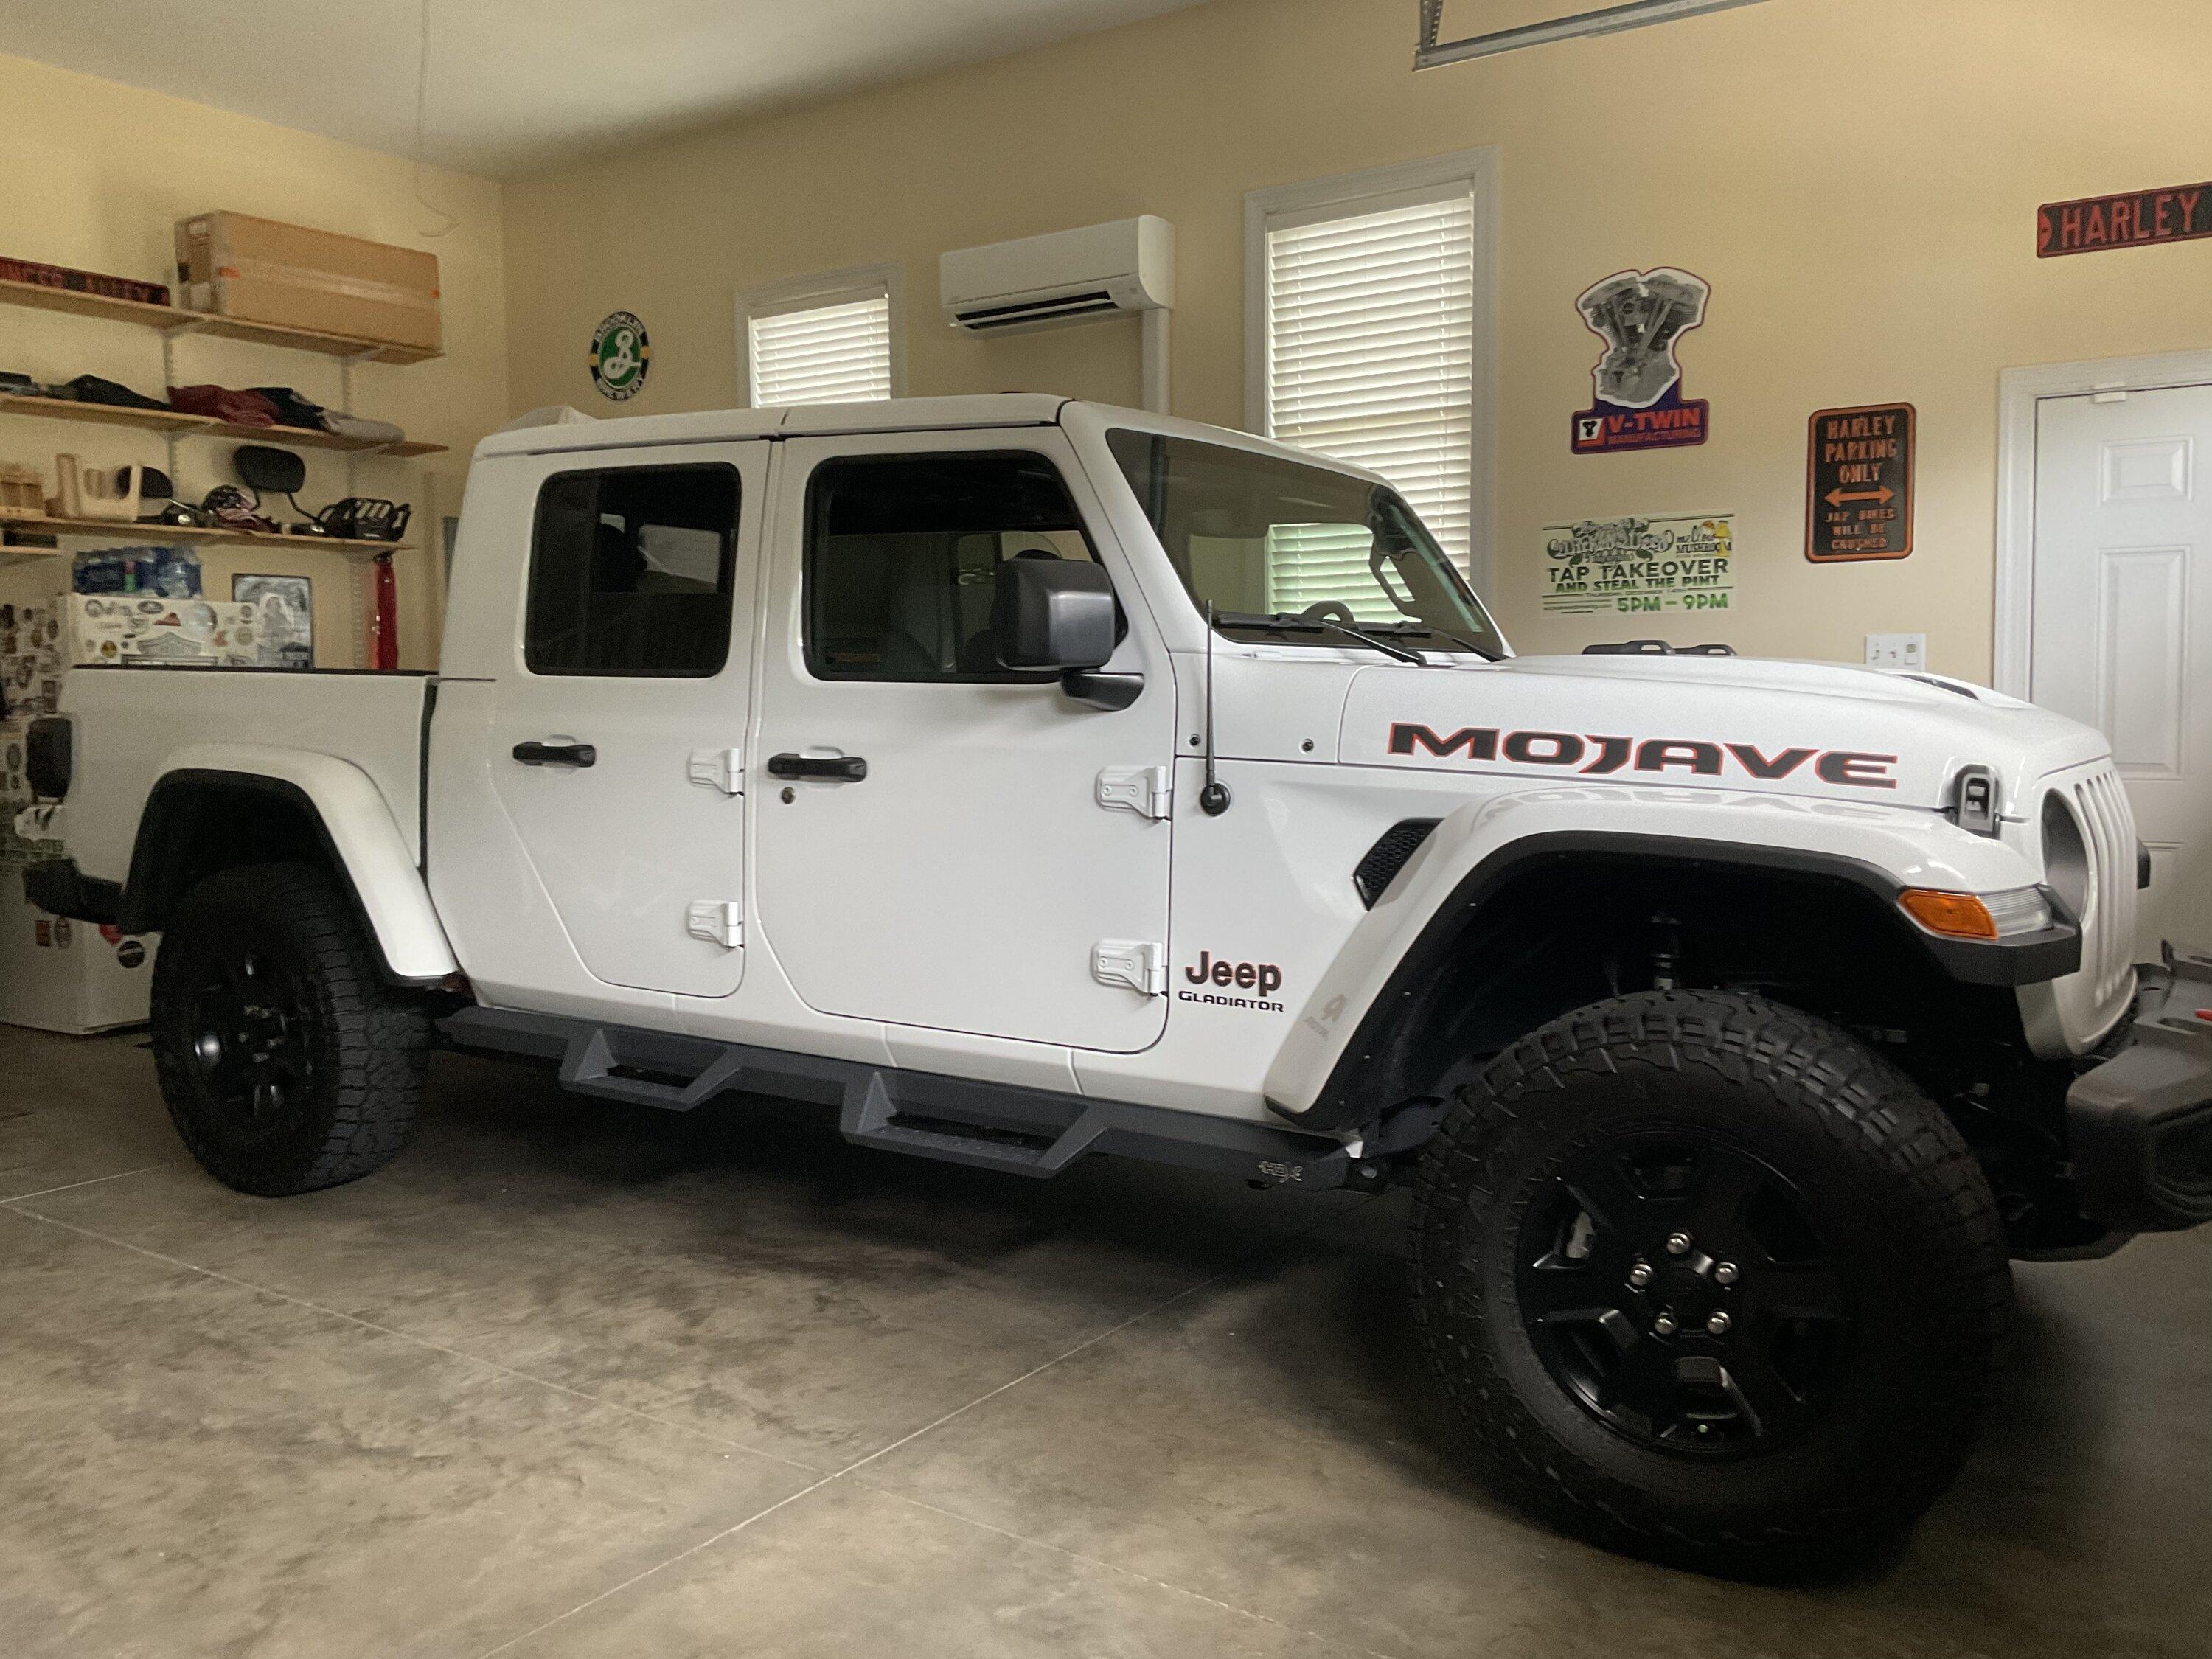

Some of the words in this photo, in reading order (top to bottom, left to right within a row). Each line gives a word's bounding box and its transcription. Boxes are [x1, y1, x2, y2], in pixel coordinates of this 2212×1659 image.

[2062, 192, 2199, 247] HARLEY
[1608, 408, 1700, 434] V-TWIN
[1826, 415, 1896, 439] HARLEY
[1825, 438, 1897, 462] PARKING
[1838, 462, 1883, 484] ONLY
[1547, 566, 1590, 582] TAP
[1599, 558, 1729, 580] TAKEOVER
[1556, 581, 1588, 593] AND
[1593, 580, 1639, 591] STEAL
[1645, 577, 1675, 588] THE
[1682, 574, 1720, 587] PINT
[1617, 596, 1662, 613] 5PM
[1683, 593, 1729, 610] 9PM
[1388, 722, 1898, 790] MOJAVE
[1185, 950, 1282, 997] Jeep
[1178, 990, 1285, 1013] GLADIATOR
